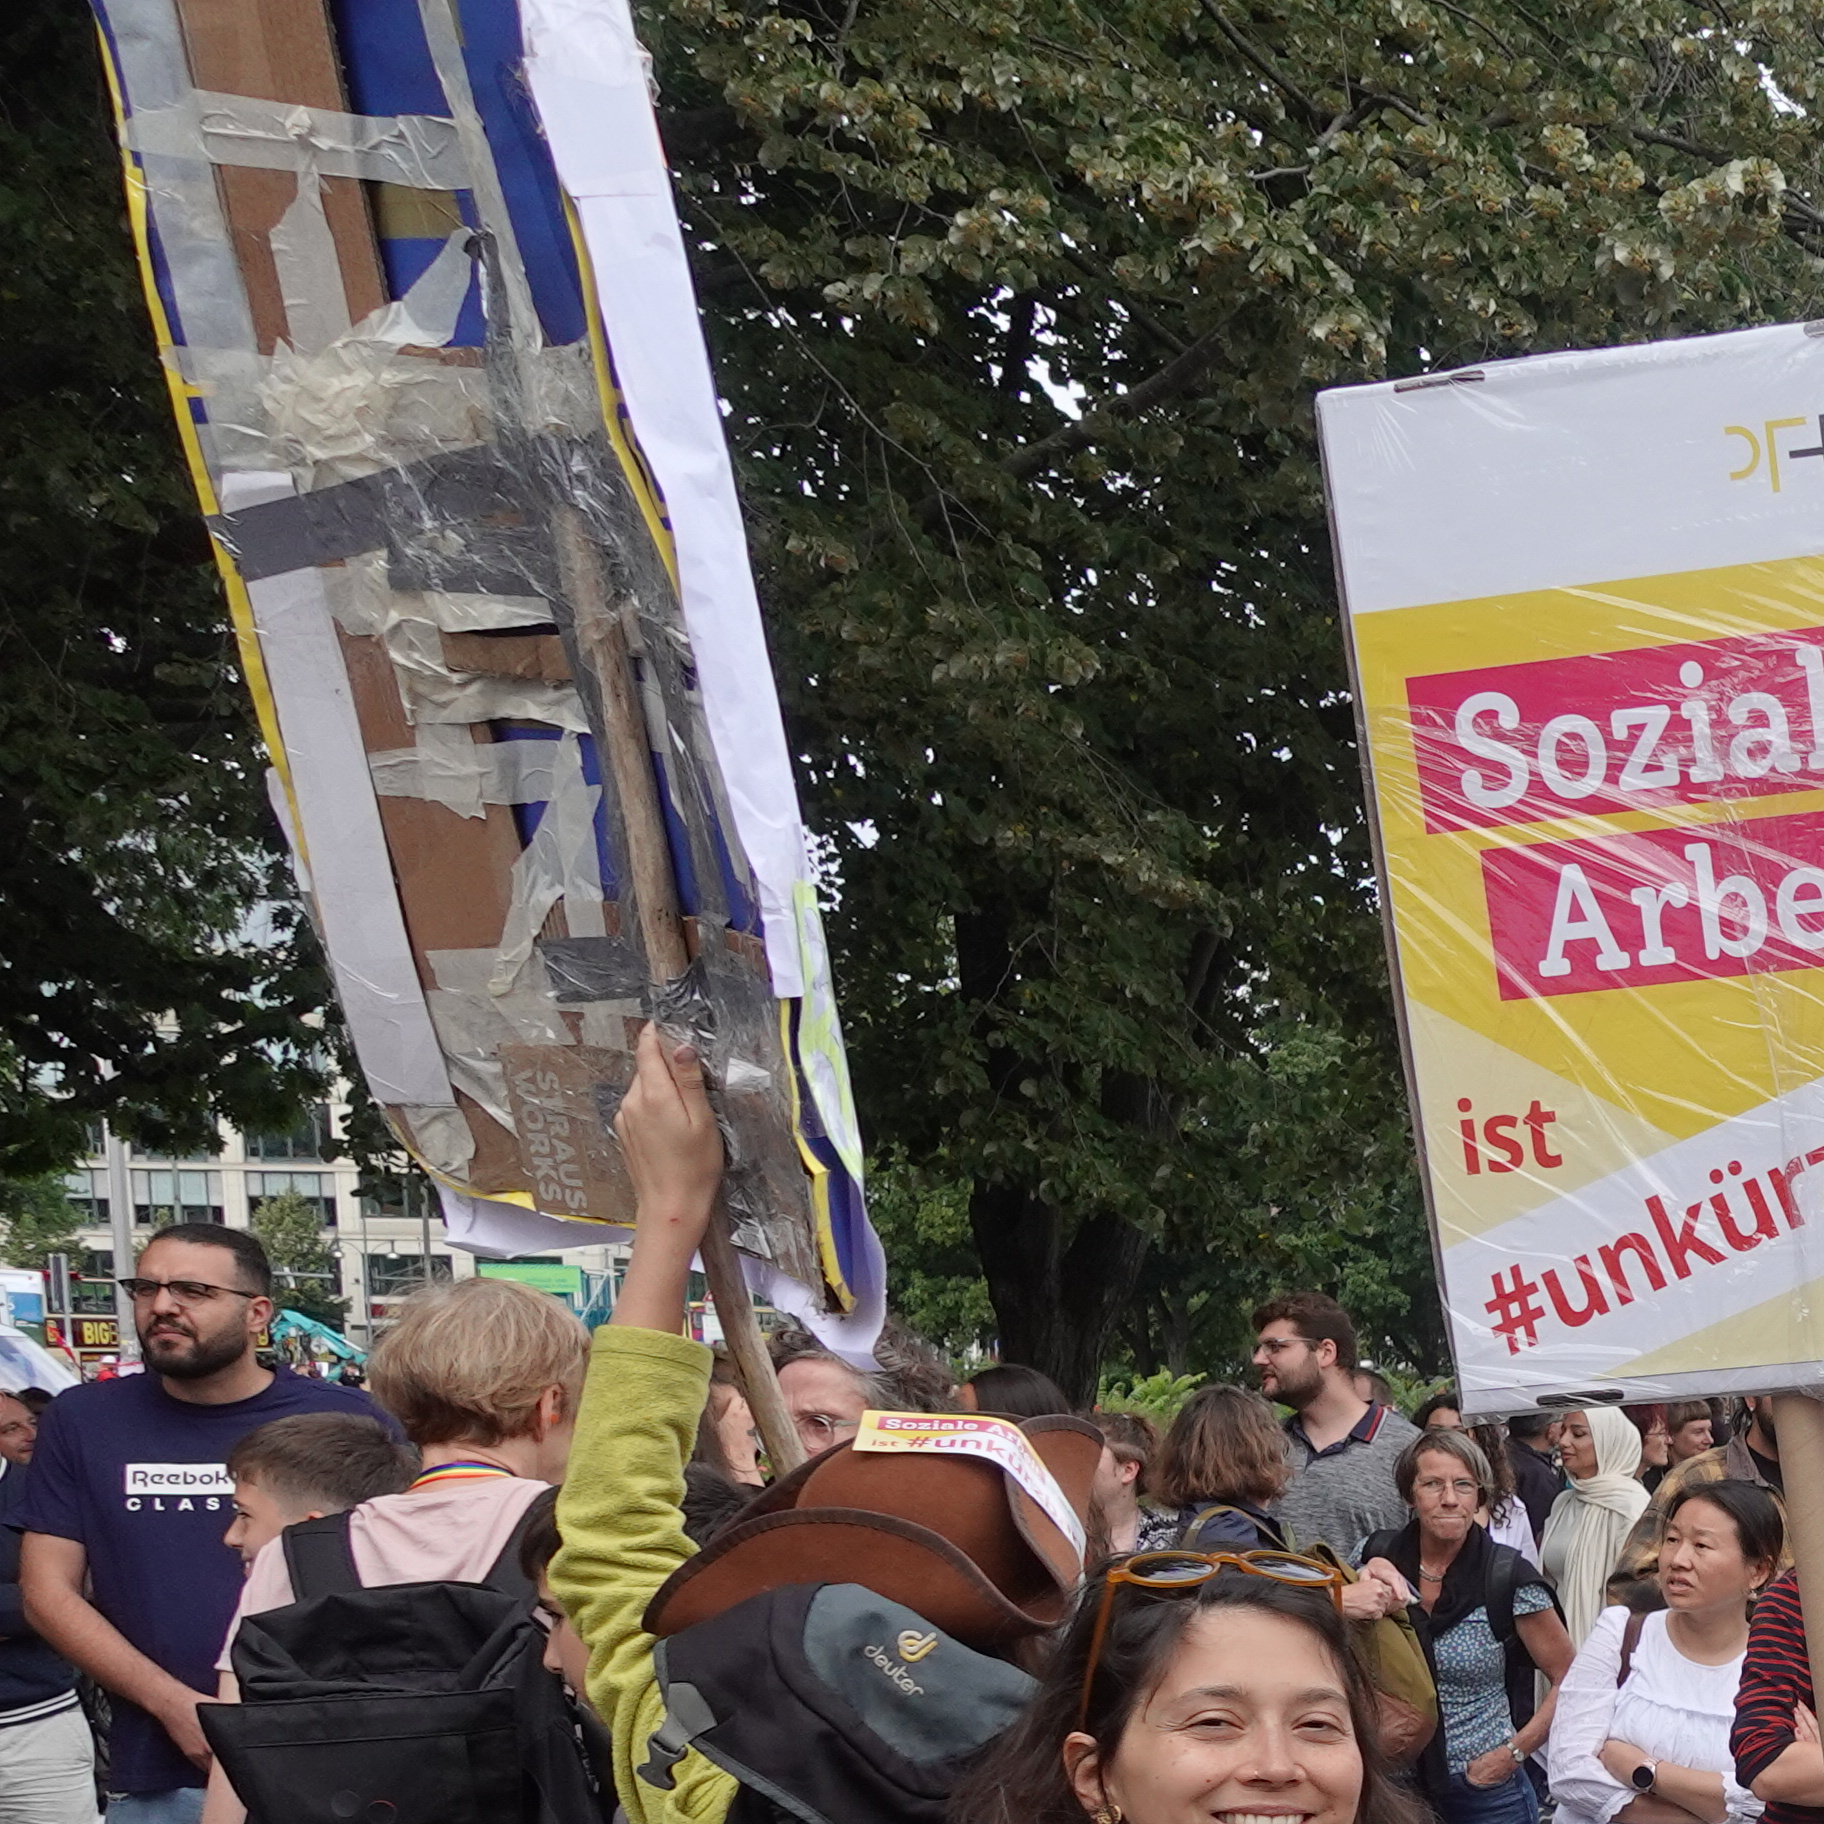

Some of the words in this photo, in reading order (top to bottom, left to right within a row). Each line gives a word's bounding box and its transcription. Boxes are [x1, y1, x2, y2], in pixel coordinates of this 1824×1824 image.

[535, 1070, 590, 1217] STRAUS
[1456, 1097, 1563, 1175] ist
[884, 1418, 978, 1431] Soziale
[871, 1438, 897, 1448] ist
[132, 1471, 229, 1487] Reebok
[864, 1645, 924, 1696] deuter
